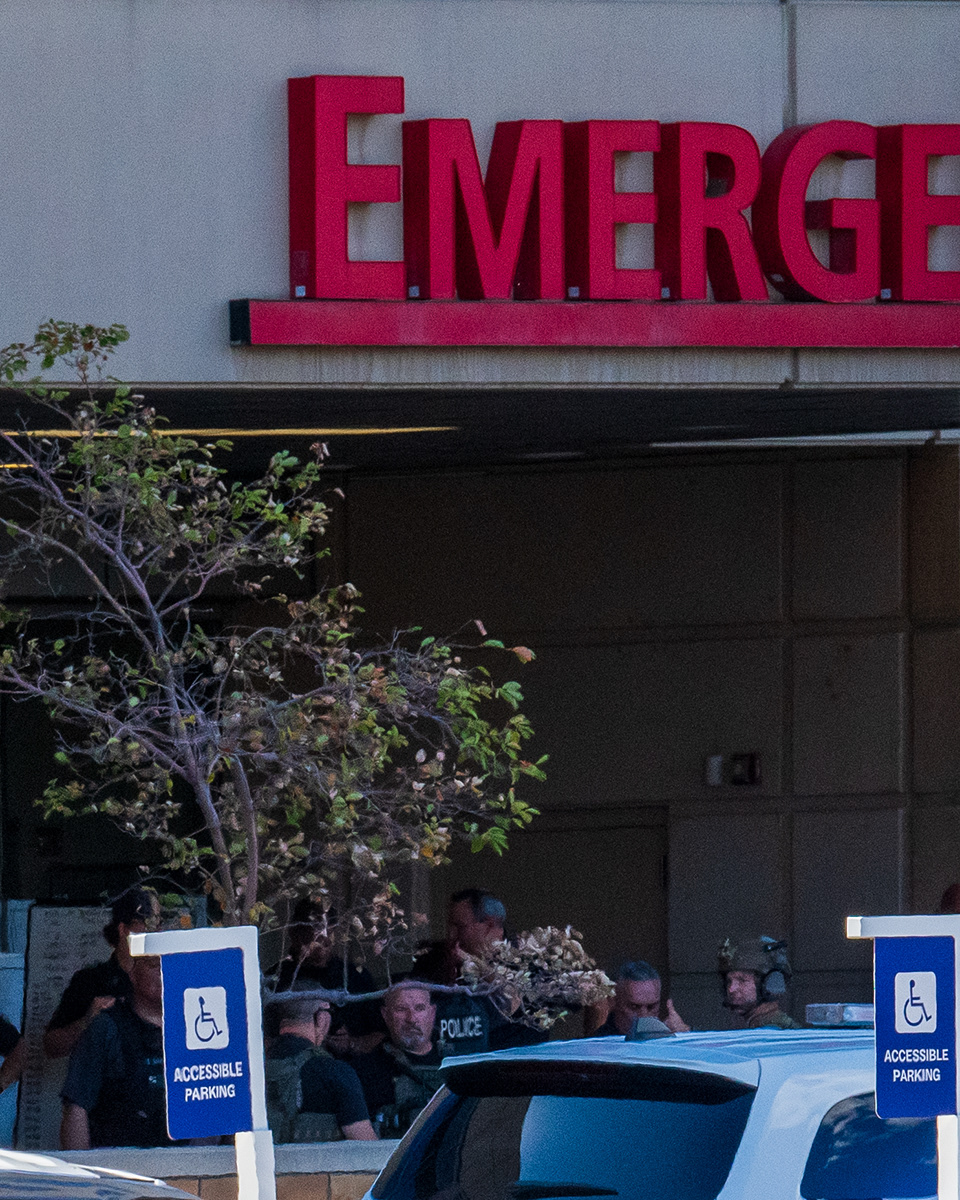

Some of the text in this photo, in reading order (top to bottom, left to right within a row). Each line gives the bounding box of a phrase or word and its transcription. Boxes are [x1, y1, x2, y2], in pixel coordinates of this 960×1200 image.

[440, 1016, 483, 1039] POLICE
[883, 1048, 949, 1063] ACCESSIBLE
[173, 1061, 243, 1082] ACCESSIBLE
[892, 1067, 941, 1082] PARKING
[184, 1083, 236, 1102] PARKING
